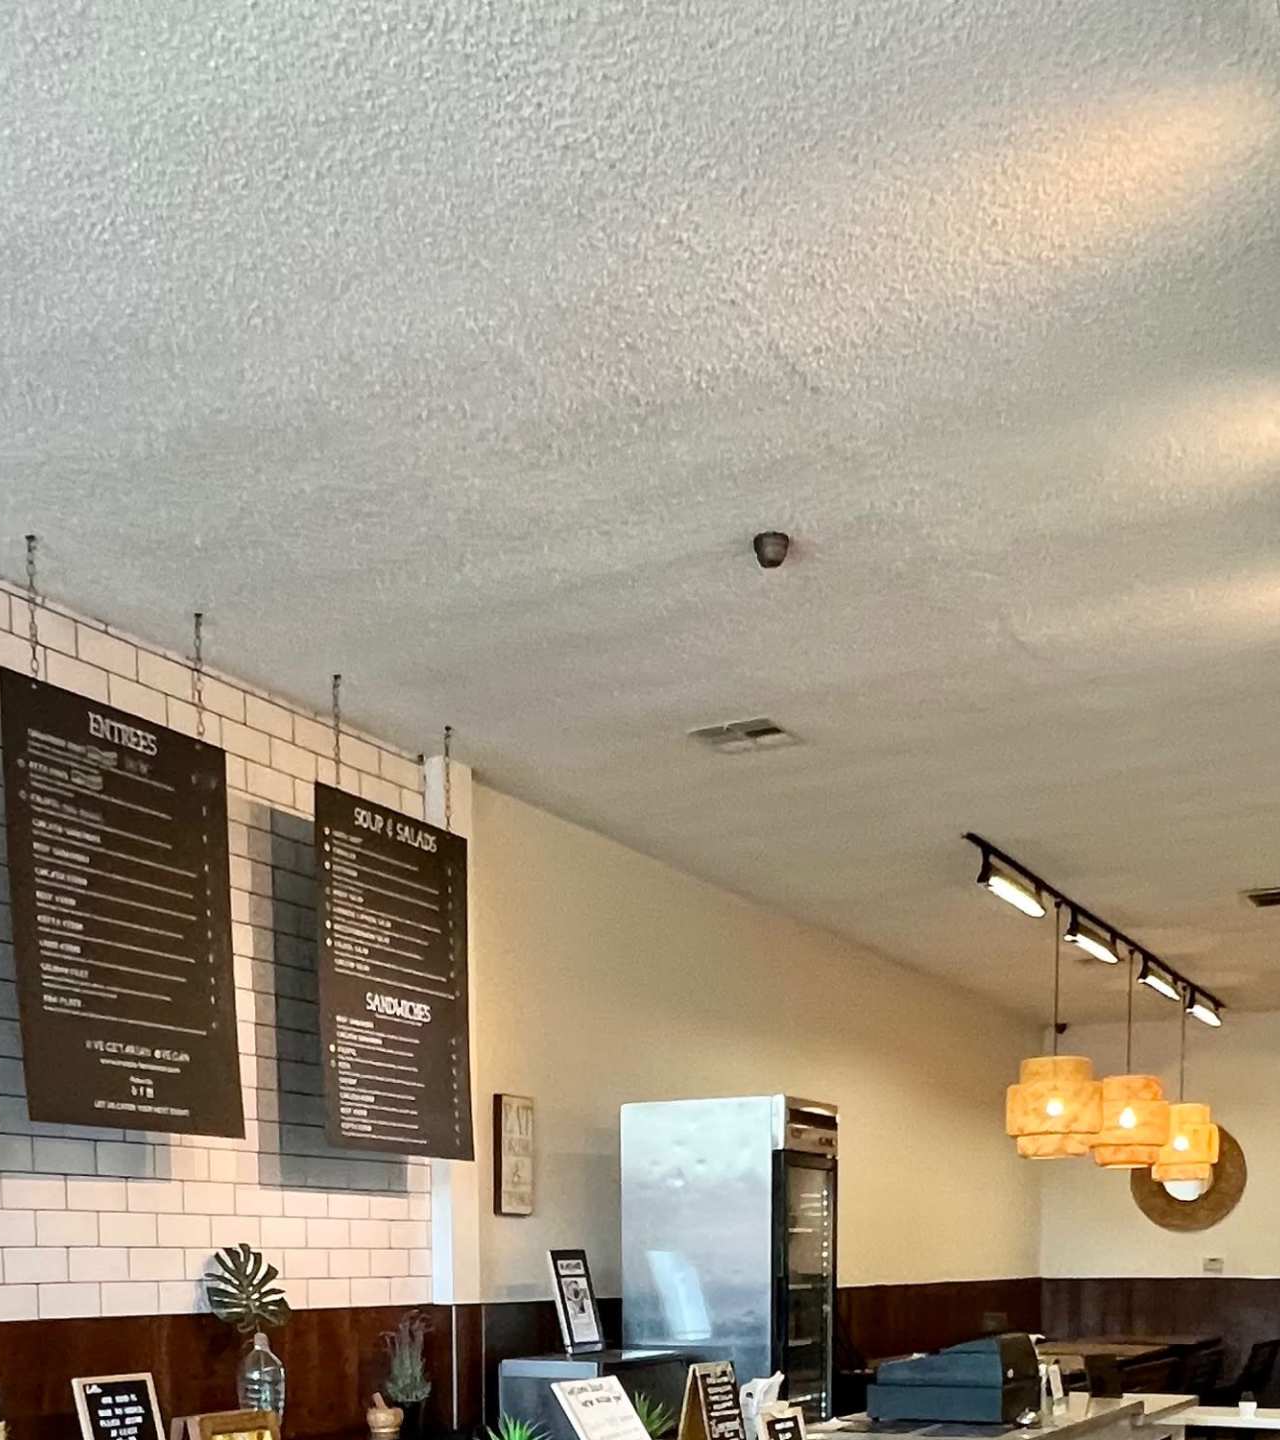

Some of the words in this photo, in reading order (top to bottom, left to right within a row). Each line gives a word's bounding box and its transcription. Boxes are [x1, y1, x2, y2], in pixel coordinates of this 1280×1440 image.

[87, 711, 159, 756] ENTREES
[353, 807, 384, 835] SOUP
[395, 821, 438, 854] SALADS
[365, 991, 432, 1023] SANDWICHES
